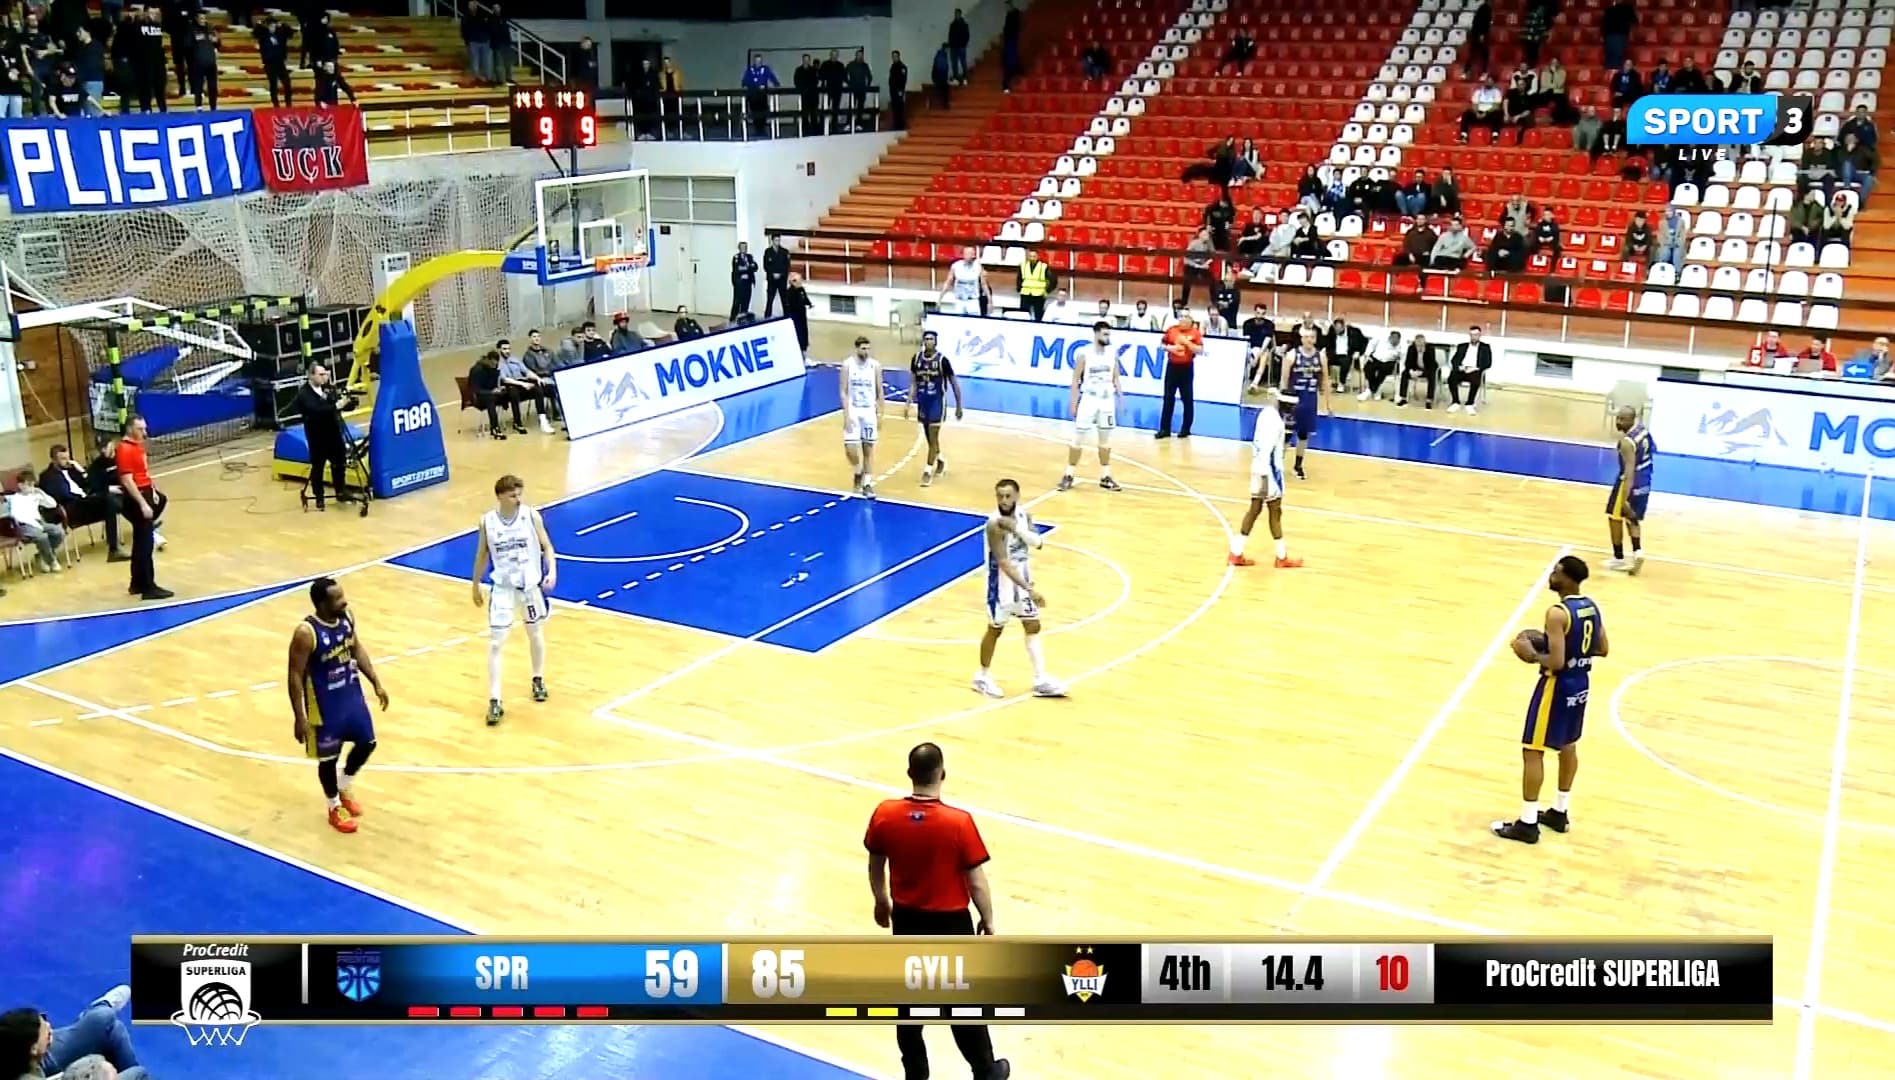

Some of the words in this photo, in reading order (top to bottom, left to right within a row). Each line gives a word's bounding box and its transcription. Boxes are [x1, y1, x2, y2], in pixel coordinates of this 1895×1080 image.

[540, 116, 553, 146] 9
[581, 116, 594, 145] 9
[8, 119, 244, 206] PLISAT
[655, 336, 775, 397] MOKNE
[393, 402, 432, 434] FIBA
[1581, 619, 1594, 655] 8
